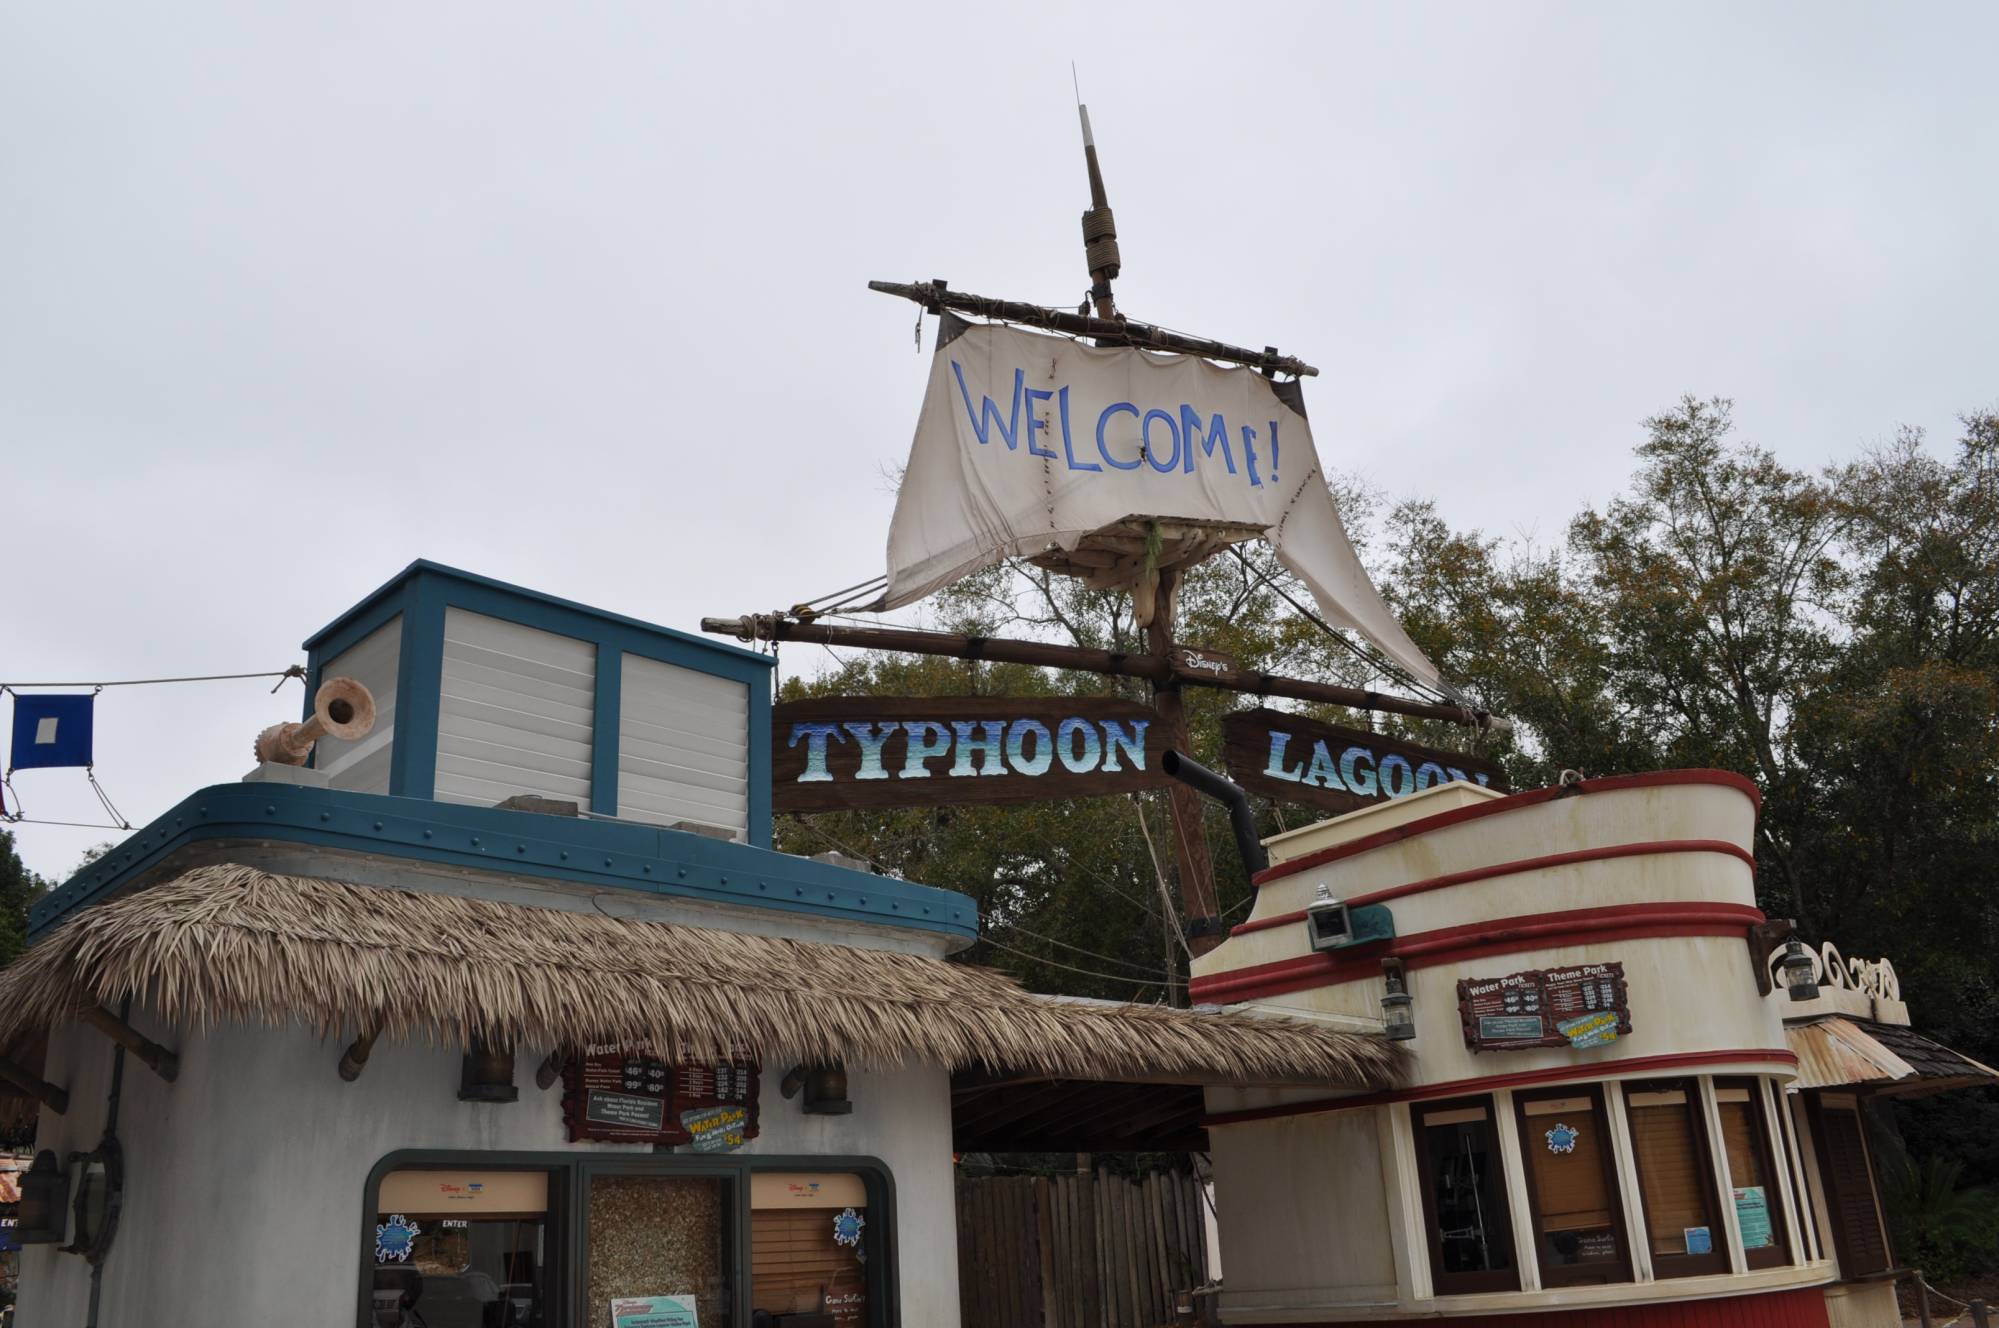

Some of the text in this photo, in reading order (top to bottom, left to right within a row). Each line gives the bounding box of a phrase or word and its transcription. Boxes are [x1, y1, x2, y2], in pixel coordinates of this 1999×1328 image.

[788, 717, 1150, 782] TYPHOON
[1548, 970, 1582, 983] Theme
[1583, 965, 1608, 977] Park
[1469, 976, 1526, 997] Water Park
[442, 1219, 468, 1229] ENTER
